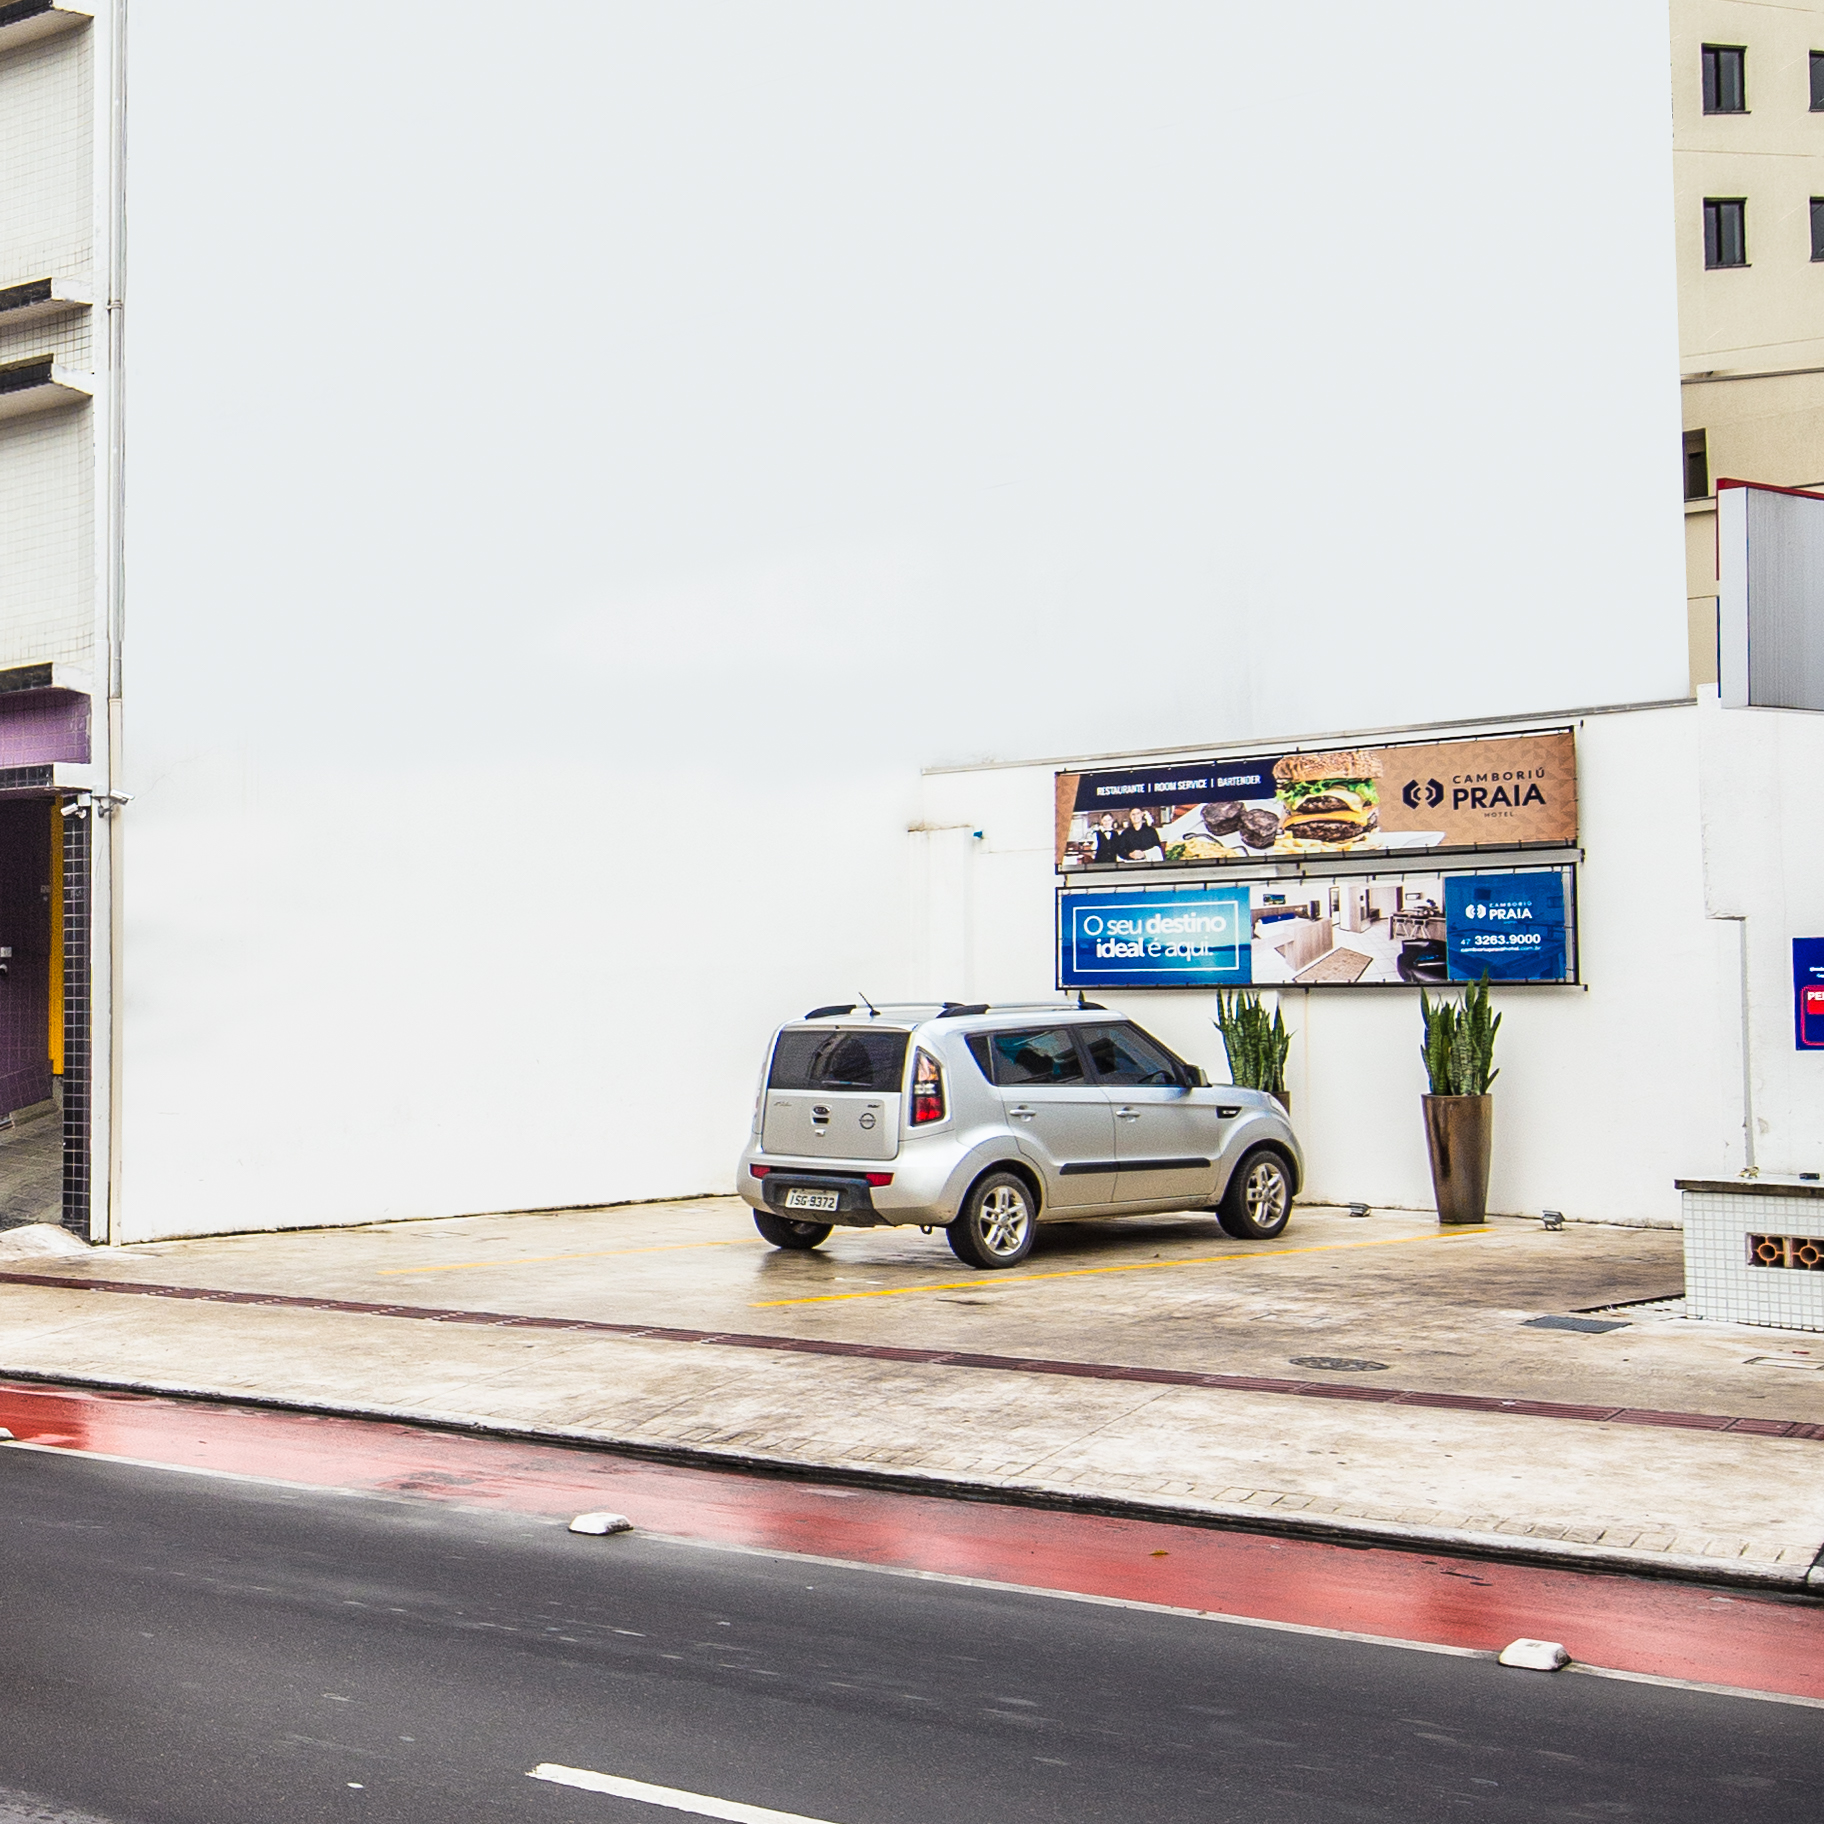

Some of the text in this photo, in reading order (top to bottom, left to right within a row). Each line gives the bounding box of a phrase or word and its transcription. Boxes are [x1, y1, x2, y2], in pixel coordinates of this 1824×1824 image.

[1096, 775, 1262, 796] RESTAURANTE ROOM SERVICE BARTENDER
[1452, 767, 1545, 784] CAMBORIÚ
[1452, 783, 1546, 810] PRAIA
[1083, 912, 1226, 936] O seu destino
[1489, 908, 1533, 920] PRAIA
[1096, 937, 1214, 962] ideal é aqui.
[1474, 933, 1541, 946] 3263.9000
